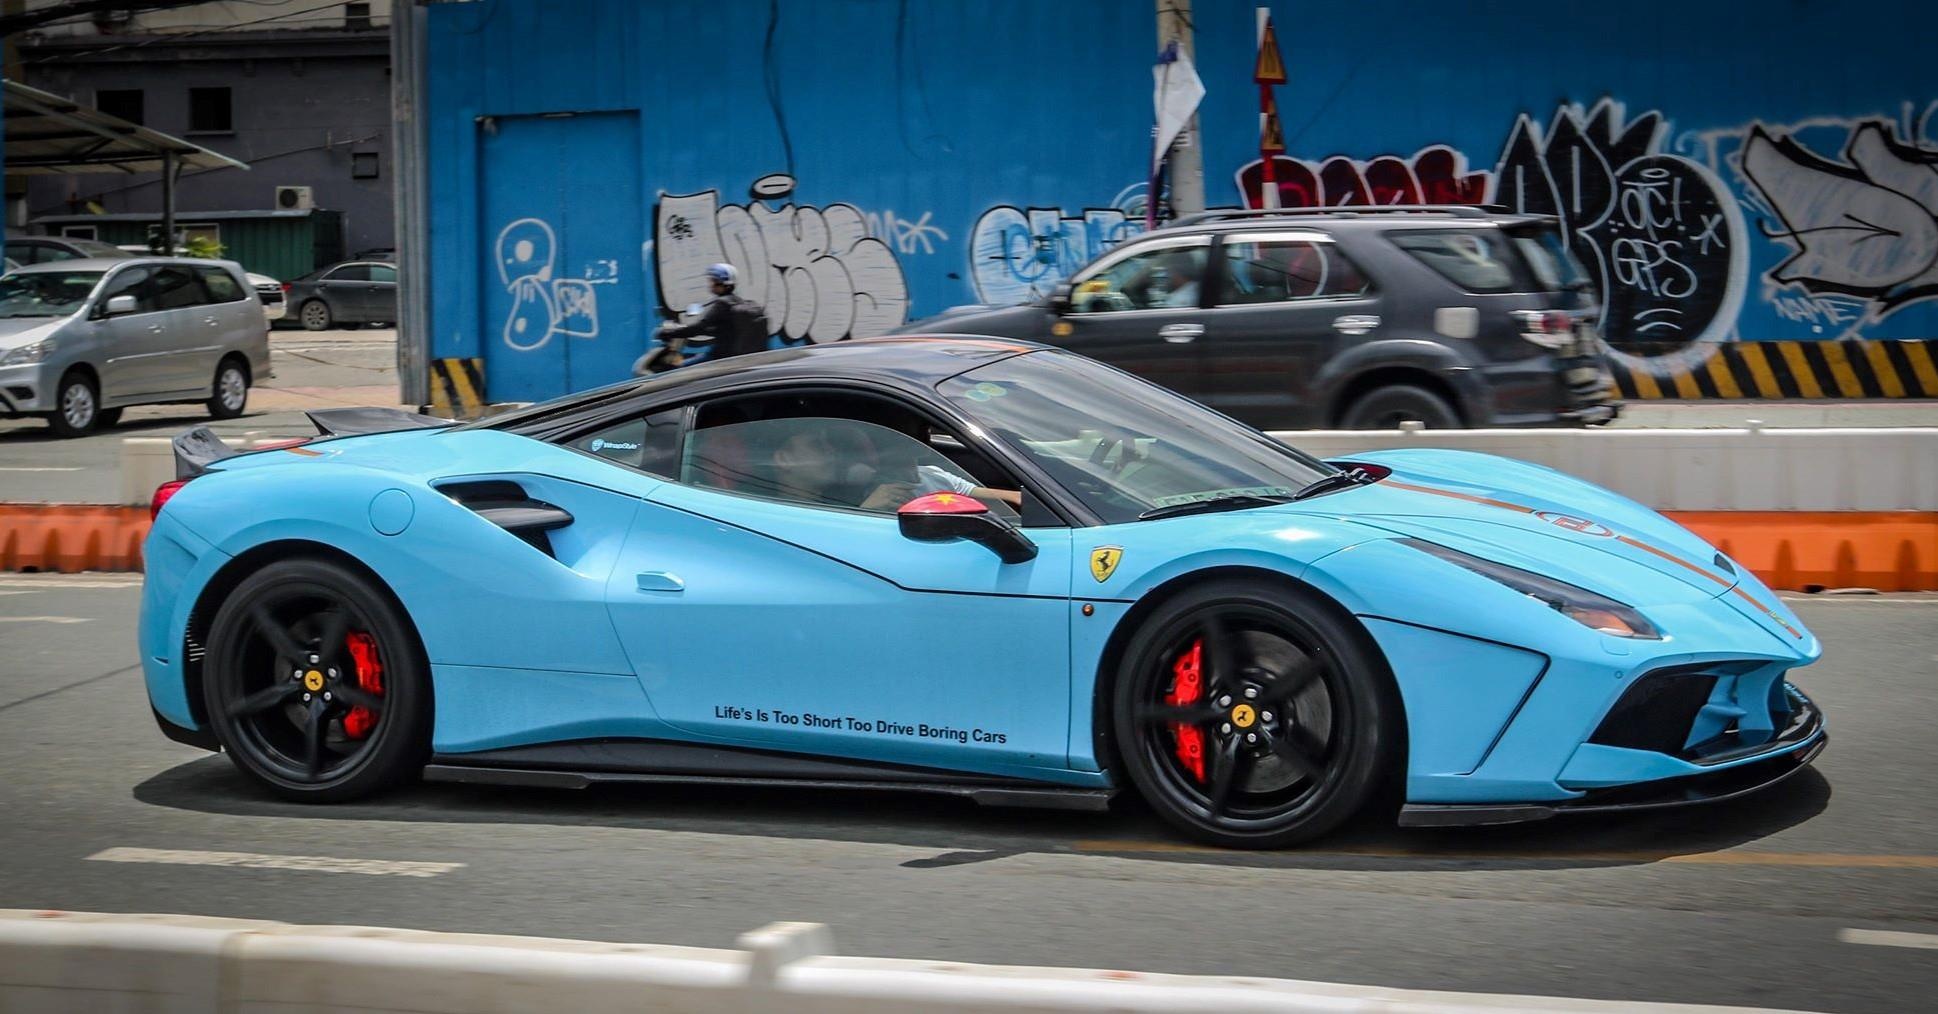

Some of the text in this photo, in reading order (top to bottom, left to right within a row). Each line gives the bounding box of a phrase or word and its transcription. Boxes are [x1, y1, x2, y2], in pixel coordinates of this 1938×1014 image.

[714, 705, 1007, 744] Life's Is Too Short Too Drive Boring Cars
